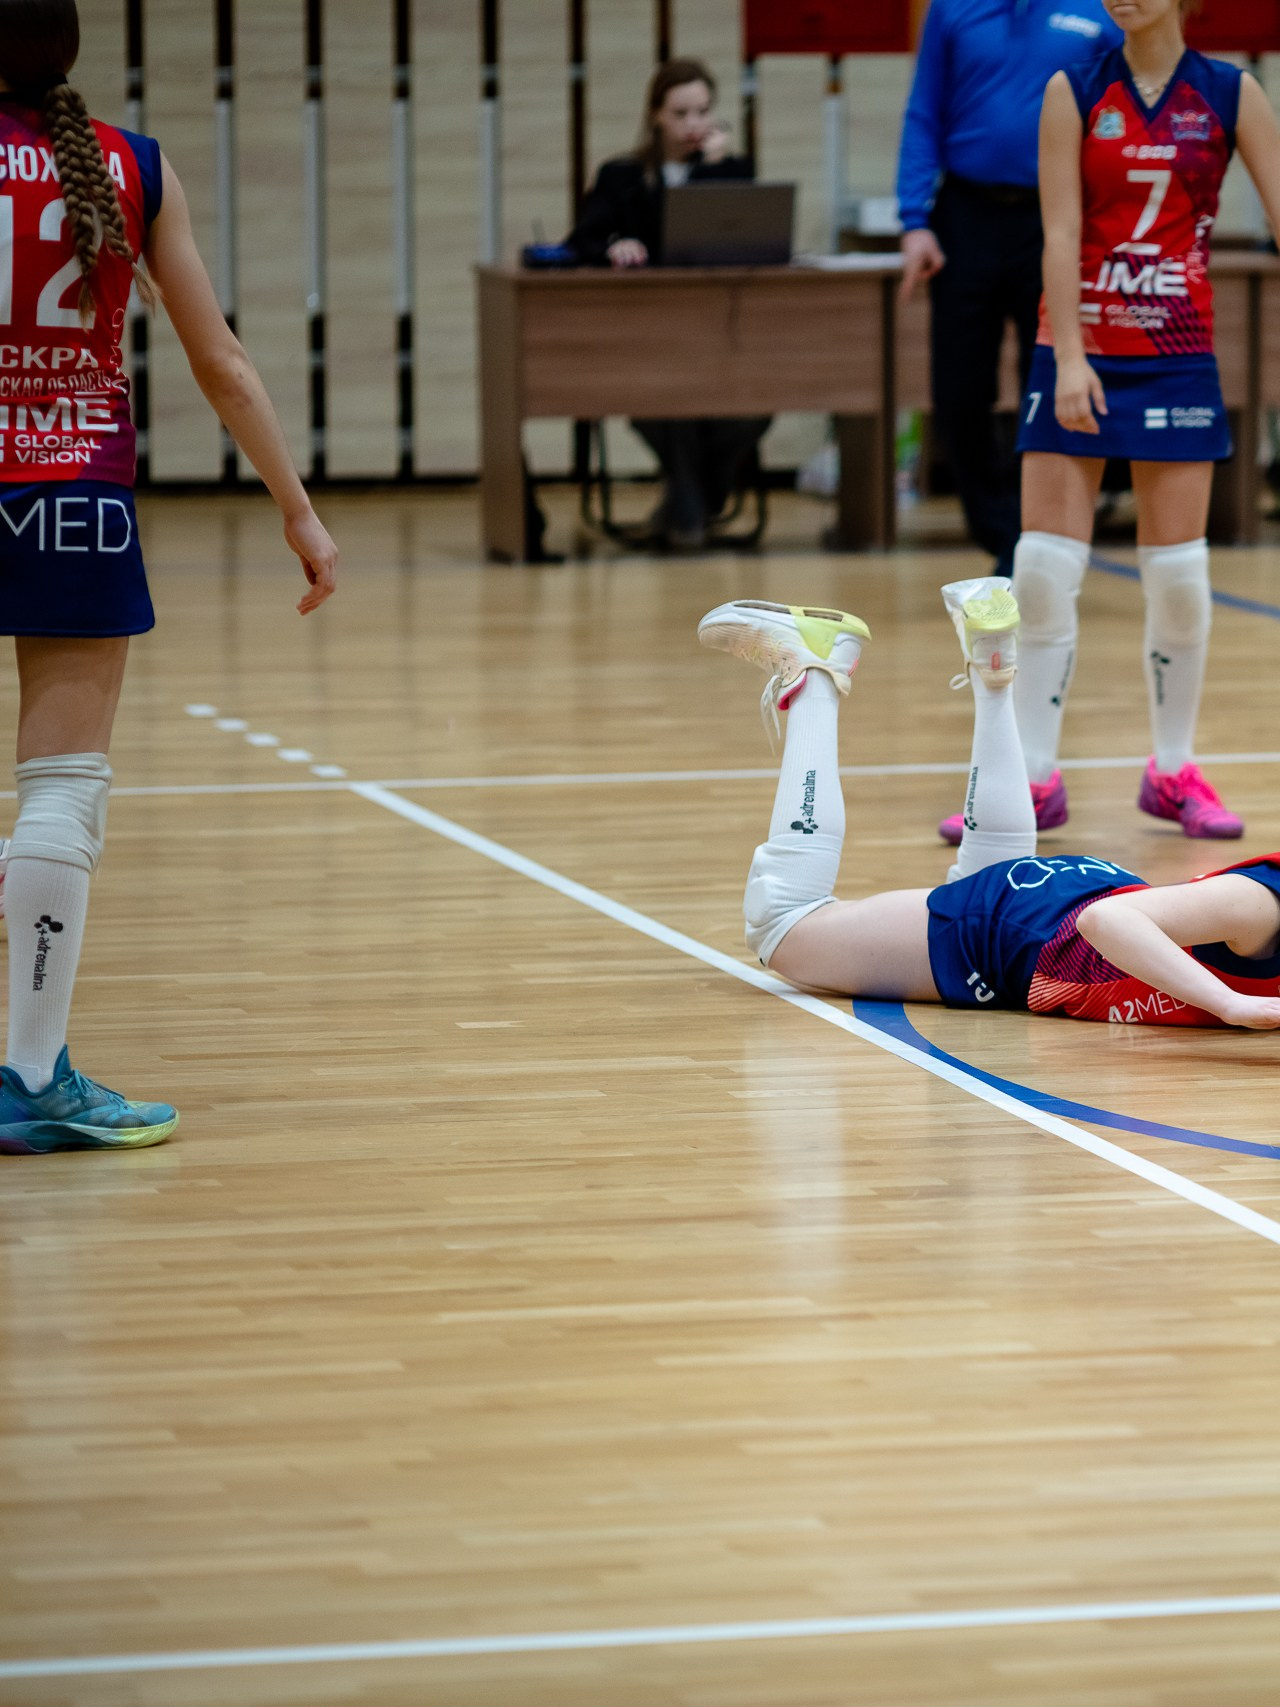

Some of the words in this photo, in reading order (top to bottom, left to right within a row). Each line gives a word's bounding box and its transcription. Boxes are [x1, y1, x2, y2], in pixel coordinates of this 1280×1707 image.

[1126, 170, 1172, 241] 7
[1080, 261, 1189, 296] IME
[1025, 391, 1043, 425] 7
[15, 433, 102, 449] GLOBAL
[15, 449, 91, 464] VISION
